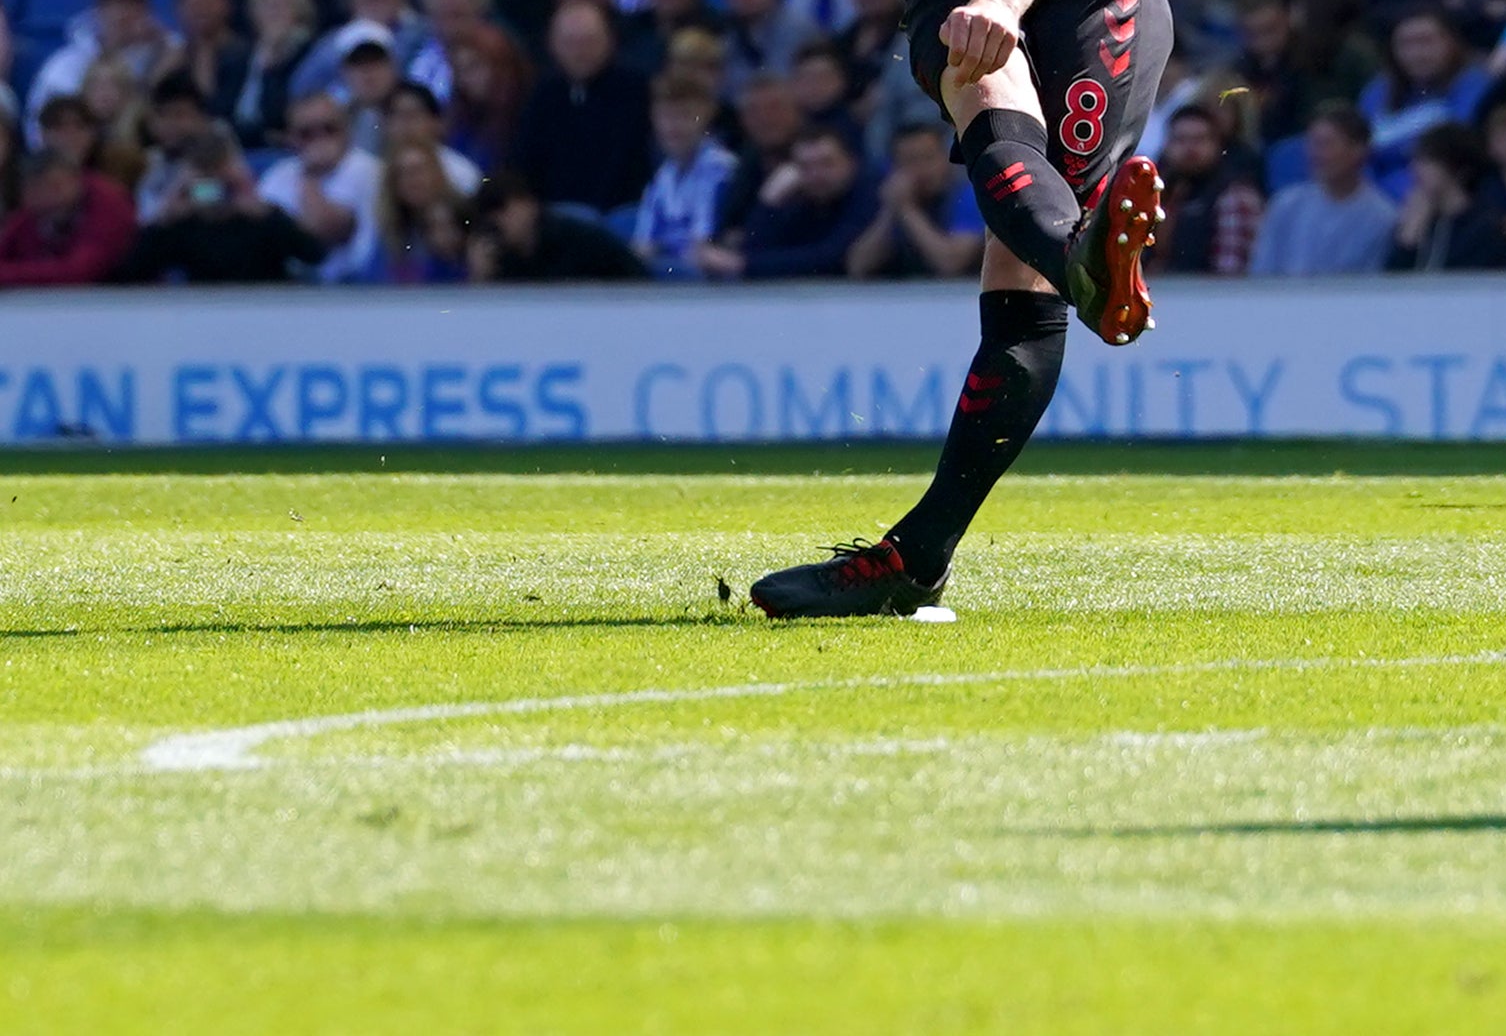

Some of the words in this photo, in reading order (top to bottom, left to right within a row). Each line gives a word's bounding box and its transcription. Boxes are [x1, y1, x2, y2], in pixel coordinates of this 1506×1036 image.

[1059, 78, 1108, 155] 8
[0, 365, 135, 439] AN
[174, 364, 586, 440] EXPRESS
[633, 360, 1286, 436] COMMNITY
